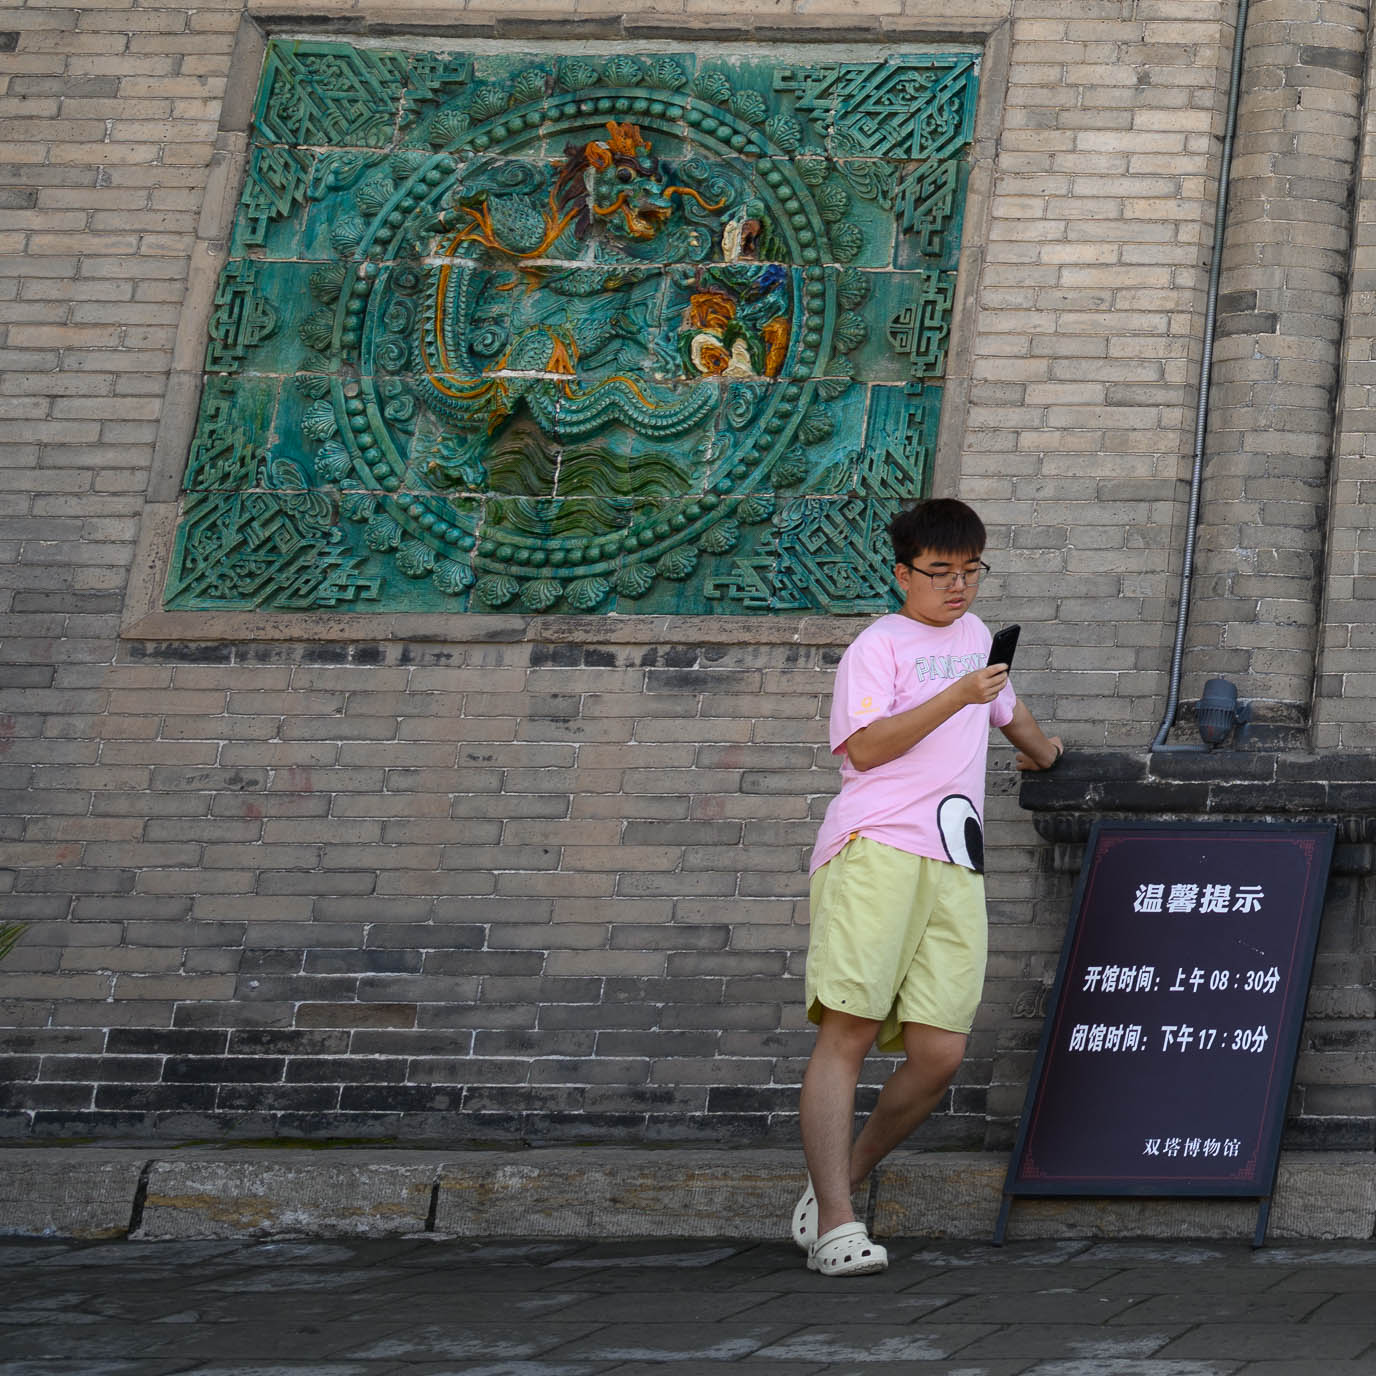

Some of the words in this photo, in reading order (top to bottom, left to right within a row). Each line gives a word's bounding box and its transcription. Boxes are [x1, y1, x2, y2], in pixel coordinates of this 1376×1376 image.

[1133, 883, 1264, 913] 温馨提示
[1142, 1137, 1241, 1157] 双塔博物馆
